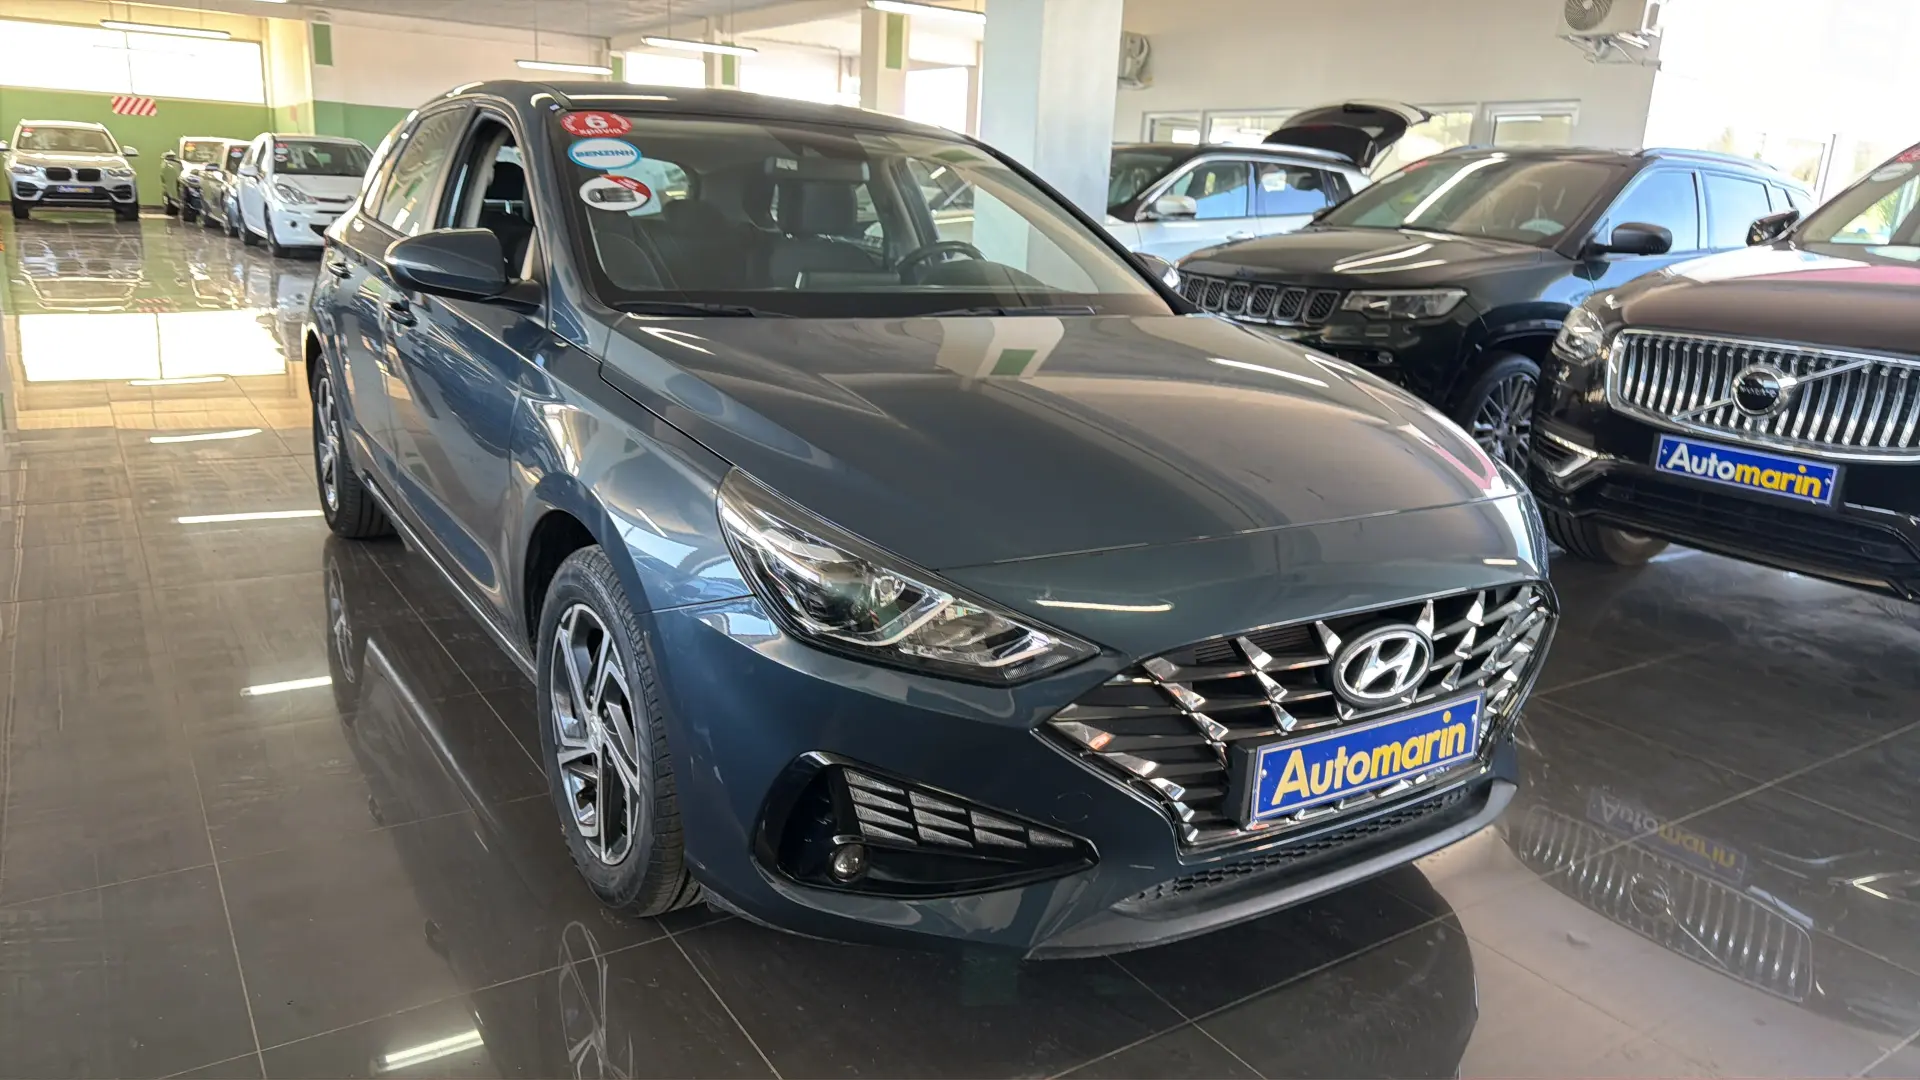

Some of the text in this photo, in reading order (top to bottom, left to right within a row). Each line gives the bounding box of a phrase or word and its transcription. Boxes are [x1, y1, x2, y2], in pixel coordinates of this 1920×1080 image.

[584, 114, 609, 129] 6
[1666, 442, 1822, 498] Automarin
[1271, 710, 1467, 806] Automarin
